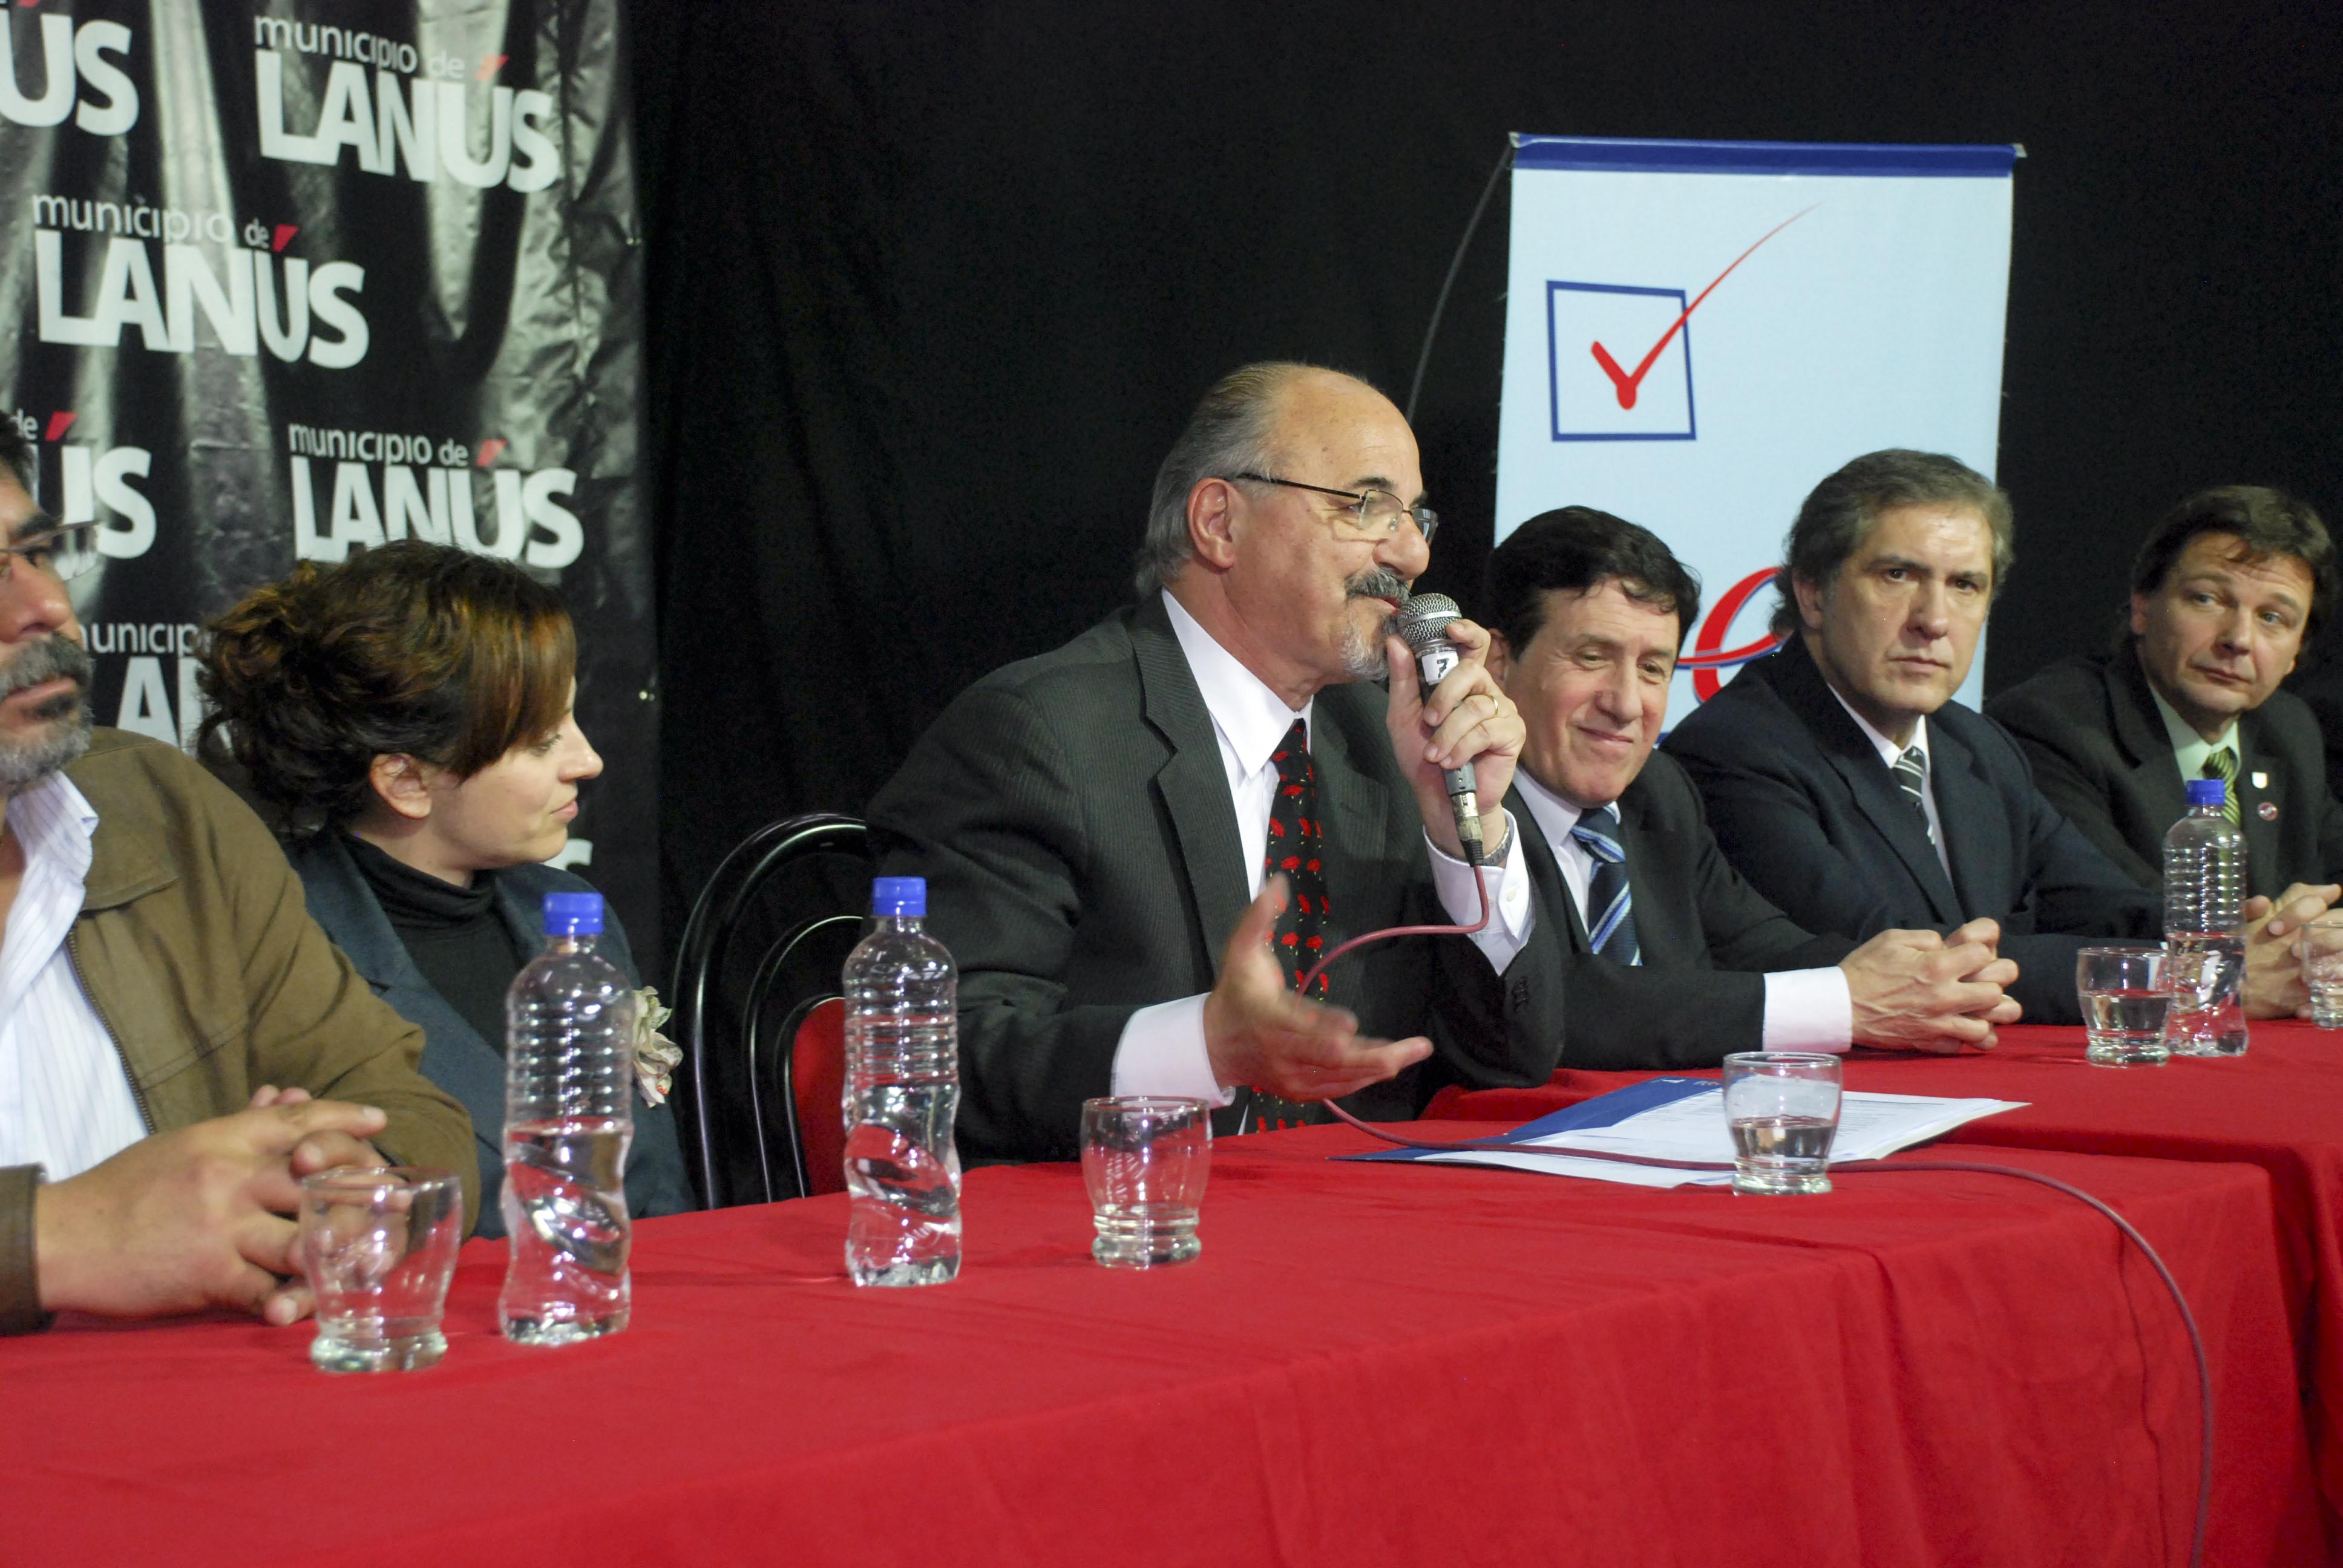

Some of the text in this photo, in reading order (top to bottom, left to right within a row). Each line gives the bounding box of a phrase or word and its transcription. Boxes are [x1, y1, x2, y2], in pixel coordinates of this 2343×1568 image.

[255, 15, 464, 79] municipio de
[255, 49, 560, 192] LANÚS
[32, 194, 270, 248] municipio de
[34, 224, 370, 369] LANÚS
[289, 423, 468, 466] municipio de
[290, 439, 584, 569] LANÚS
